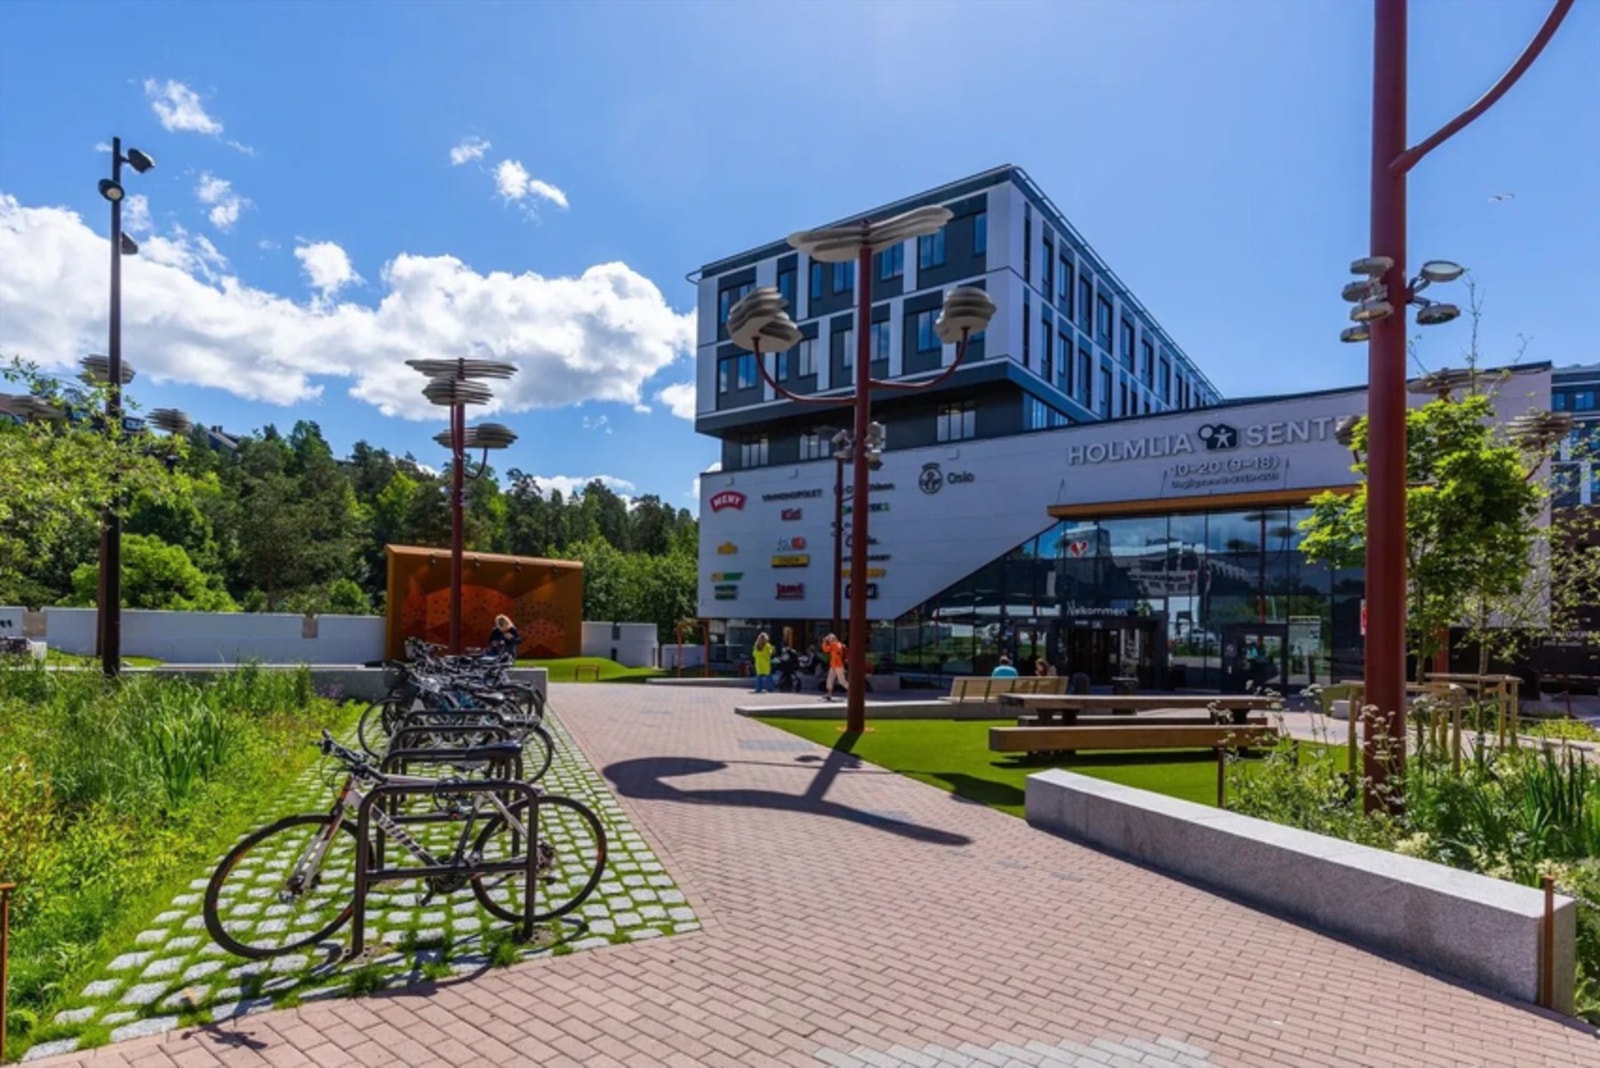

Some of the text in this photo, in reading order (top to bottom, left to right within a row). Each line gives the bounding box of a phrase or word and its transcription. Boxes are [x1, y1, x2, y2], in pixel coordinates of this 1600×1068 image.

[1067, 416, 1346, 465] HOLMLIA SENT
[946, 471, 975, 484] Oslo
[713, 493, 742, 508] MENY
